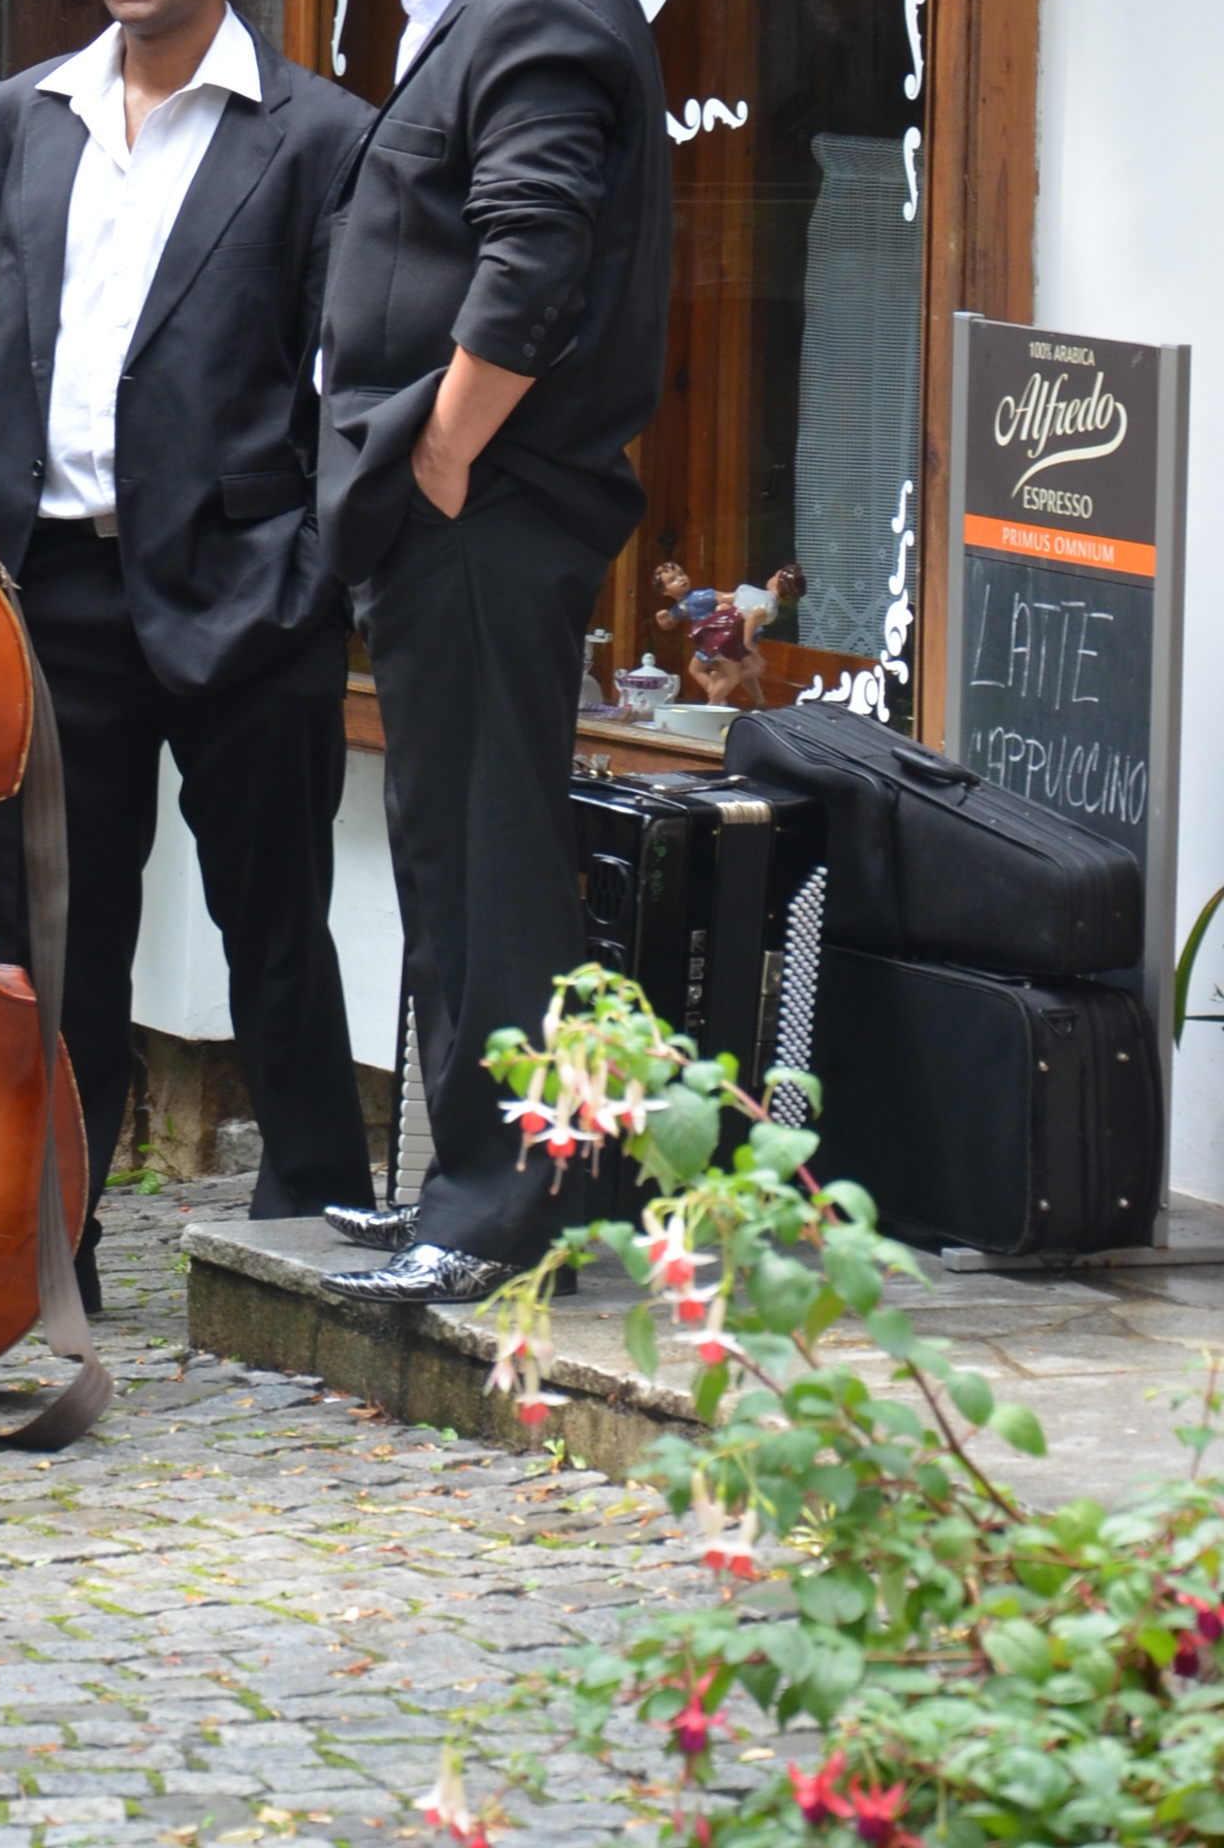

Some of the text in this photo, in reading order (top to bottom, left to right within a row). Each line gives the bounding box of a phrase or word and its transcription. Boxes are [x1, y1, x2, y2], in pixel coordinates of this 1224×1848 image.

[1029, 341, 1095, 366] 100% ARABICA
[994, 371, 1126, 460] Alfredo
[1022, 486, 1093, 519] ESPRESSO
[1002, 527, 1114, 564] PRIMUS OMNIUM
[969, 583, 1114, 710] LATTE
